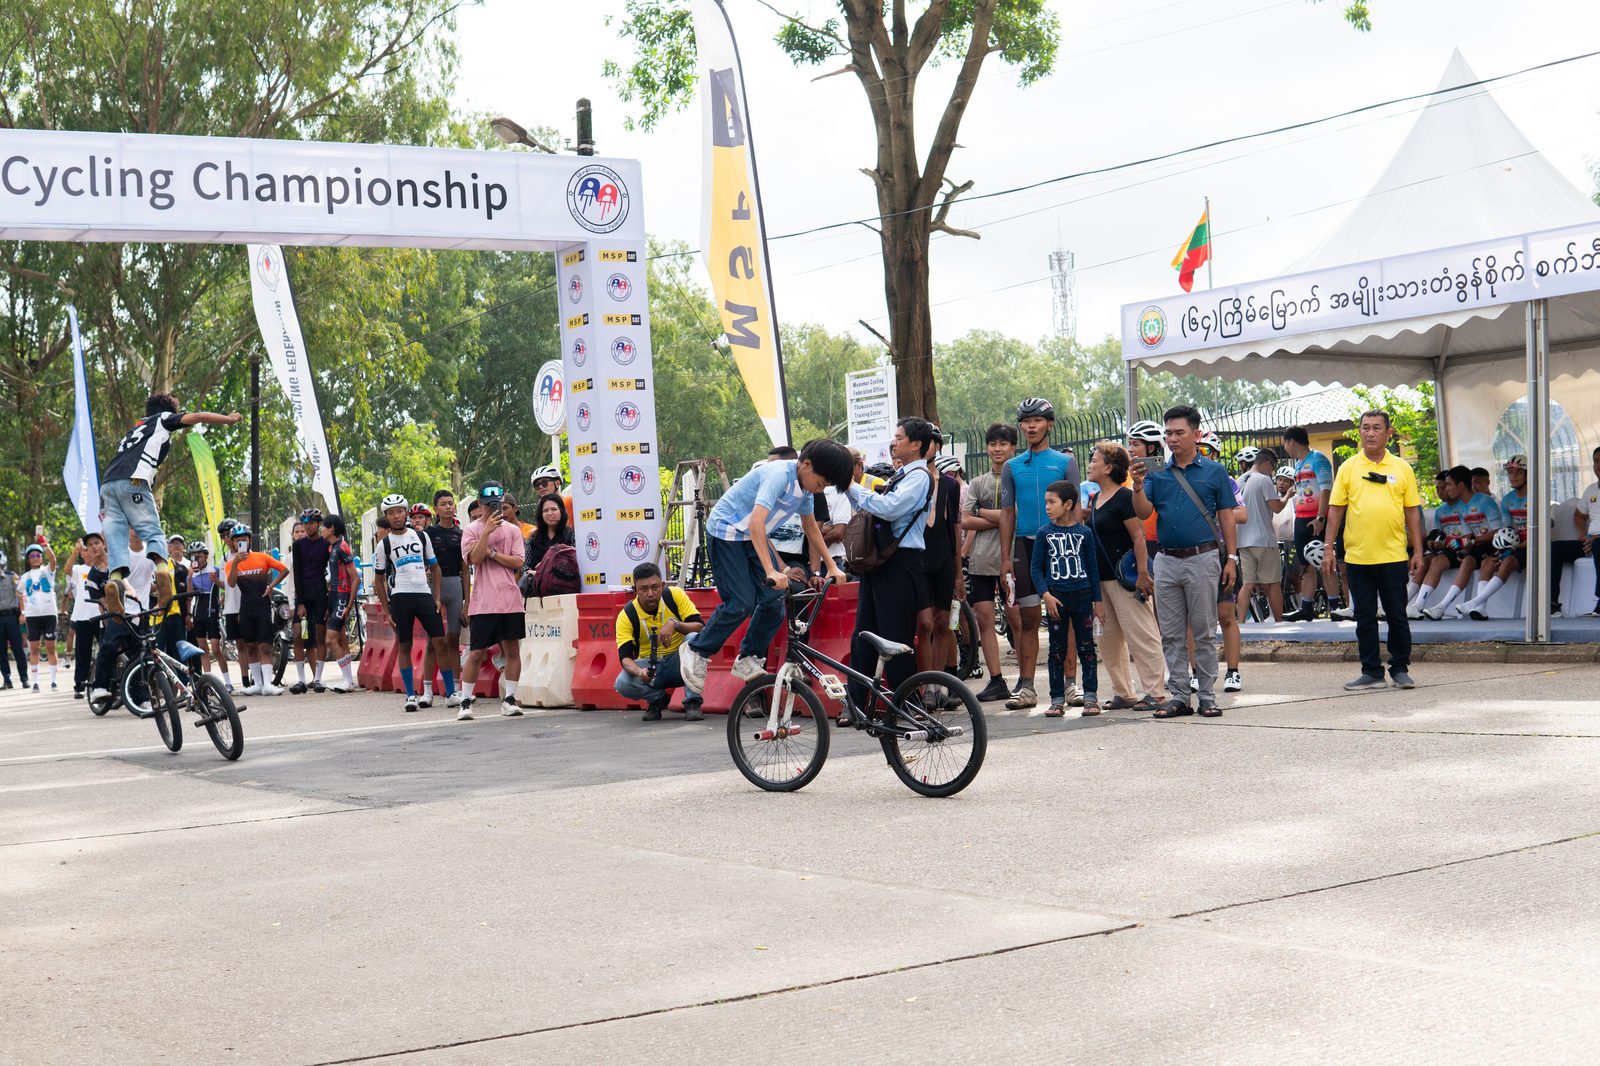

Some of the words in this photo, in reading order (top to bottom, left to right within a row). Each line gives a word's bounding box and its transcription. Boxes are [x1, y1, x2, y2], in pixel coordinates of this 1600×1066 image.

[1, 155, 176, 210] Cycling
[193, 160, 508, 220] Championship
[572, 208, 589, 228] Myanmar
[602, 252, 623, 260] MSP
[573, 382, 585, 391] MSP
[870, 378, 884, 386] Cycling
[873, 386, 885, 394] Office
[577, 445, 590, 454] MSP
[582, 511, 594, 519] MSP
[1046, 532, 1084, 556] STAY
[393, 542, 421, 558] TYC
[1050, 555, 1087, 580] COOL
[587, 575, 598, 583] MSP
